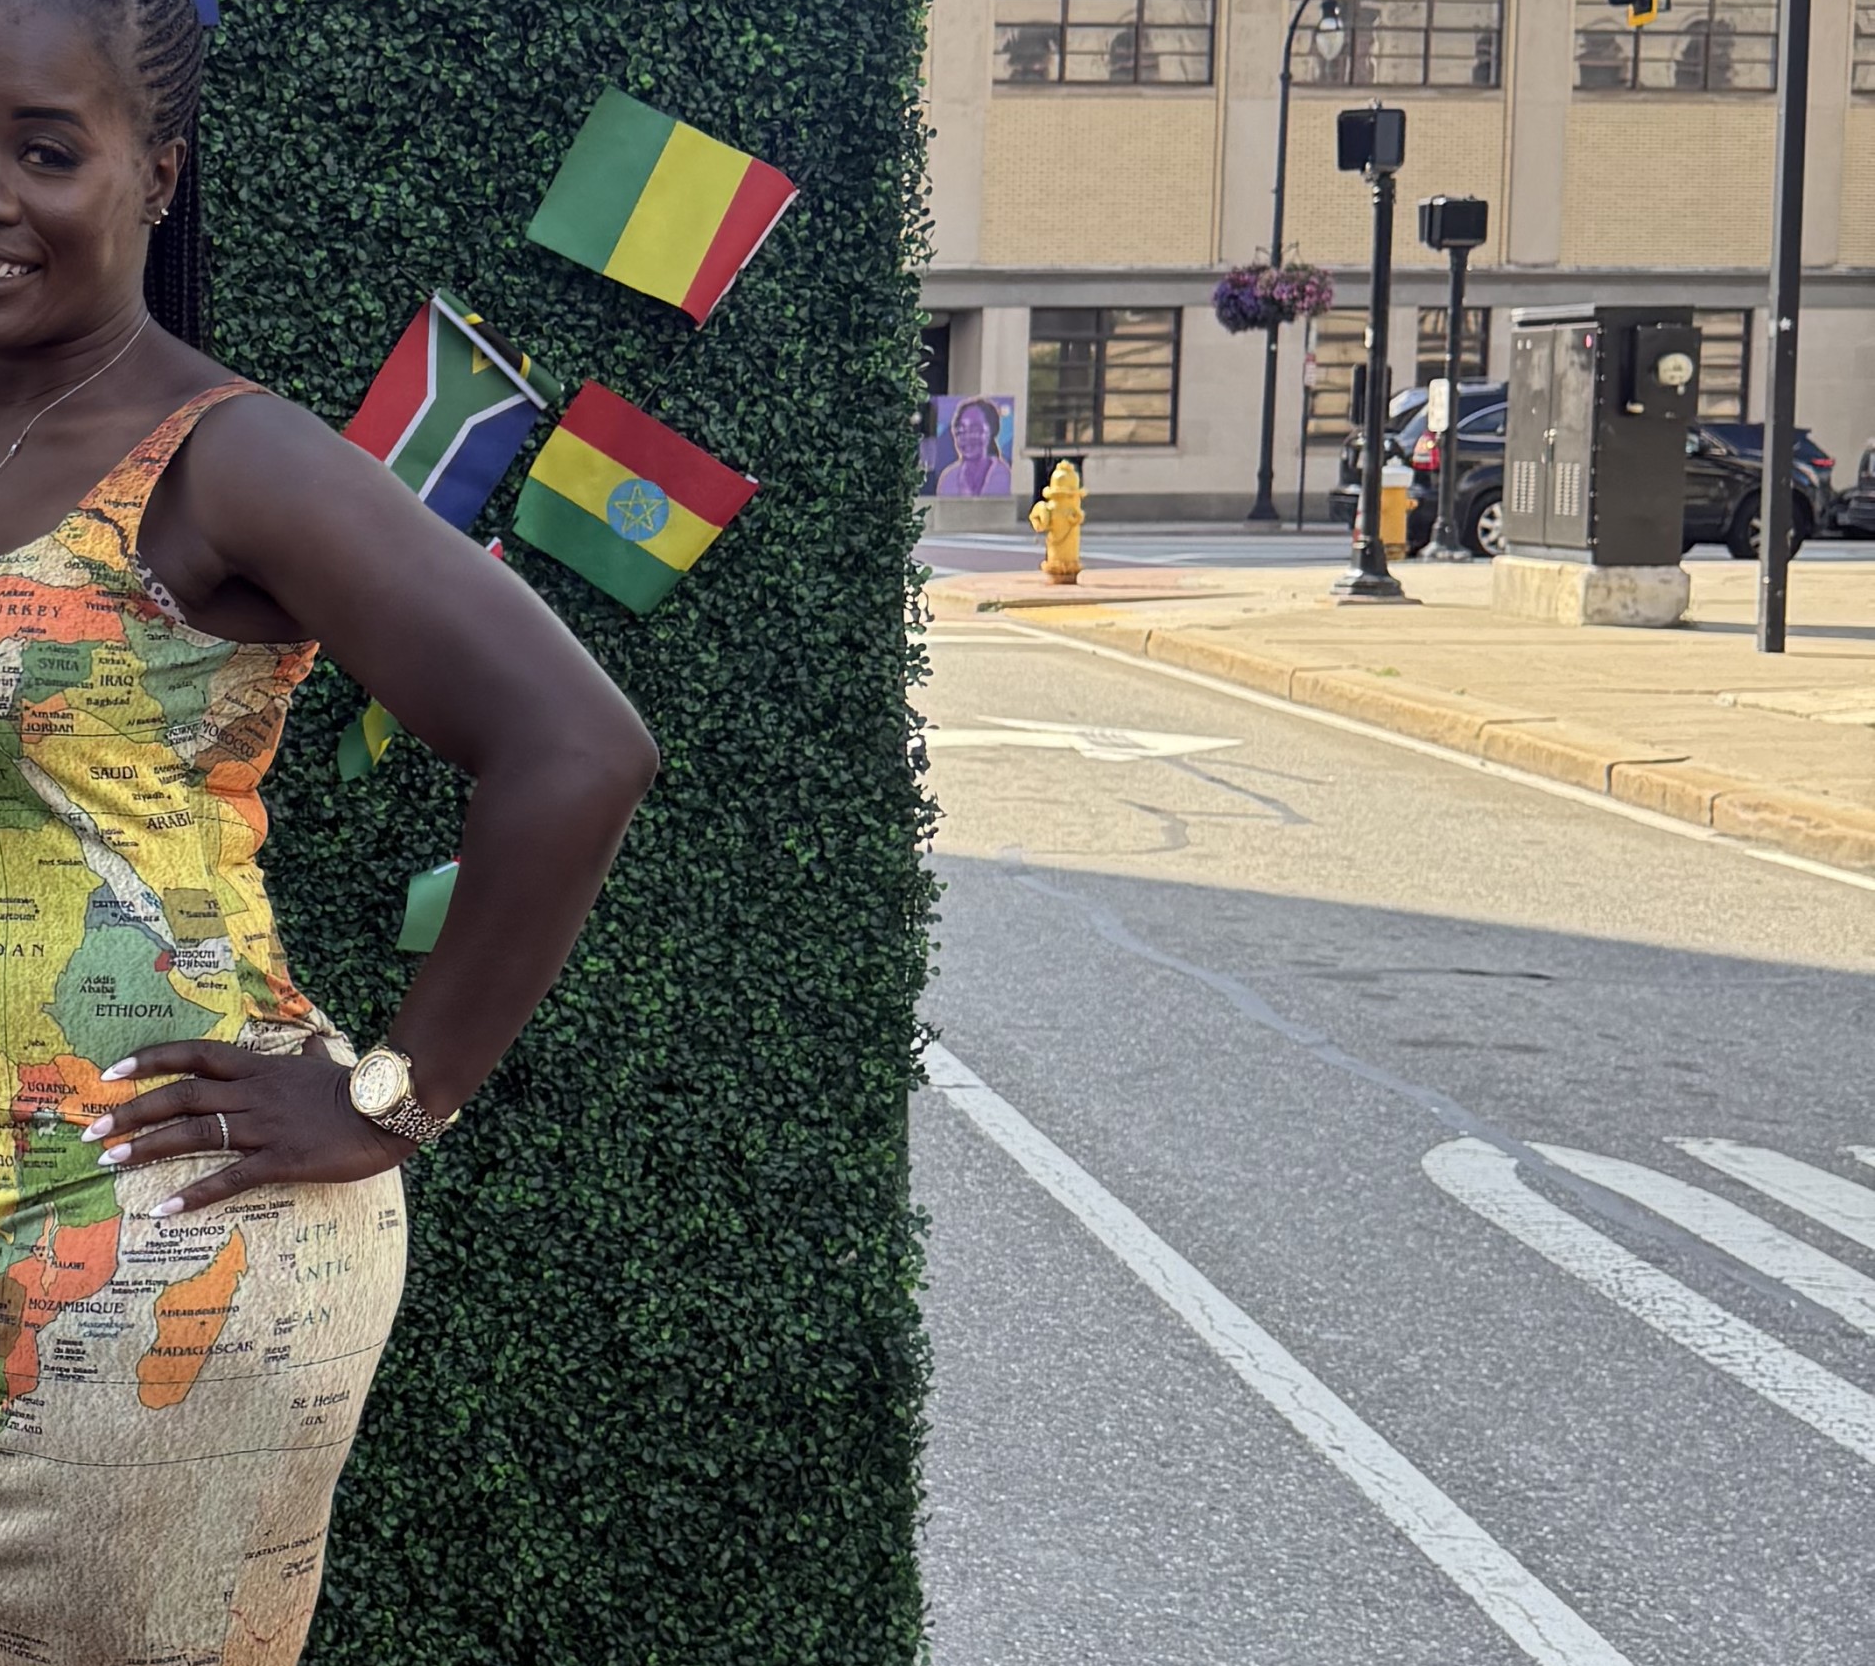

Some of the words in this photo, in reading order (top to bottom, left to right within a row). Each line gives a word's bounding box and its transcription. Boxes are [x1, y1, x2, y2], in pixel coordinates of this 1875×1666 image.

[38, 658, 80, 672] SYRIA
[99, 674, 135, 687] IRAQ
[86, 696, 130, 708] Baghdad
[29, 710, 74, 721] Amman
[23, 722, 75, 734] JORDAN
[201, 720, 255, 758] MOROCCO
[90, 764, 139, 780] SAUDI
[146, 810, 196, 831] ARABI
[94, 1003, 175, 1018] ETHIOPIA
[27, 1082, 80, 1095] UGANDA
[81, 1101, 120, 1114] KENY
[158, 1225, 226, 1239] COMOROS
[295, 1219, 339, 1244] UTH
[295, 1254, 353, 1284] NTIC
[28, 1297, 126, 1315] MOZAMBIQUE
[149, 1340, 254, 1357] MADAGASCAR
